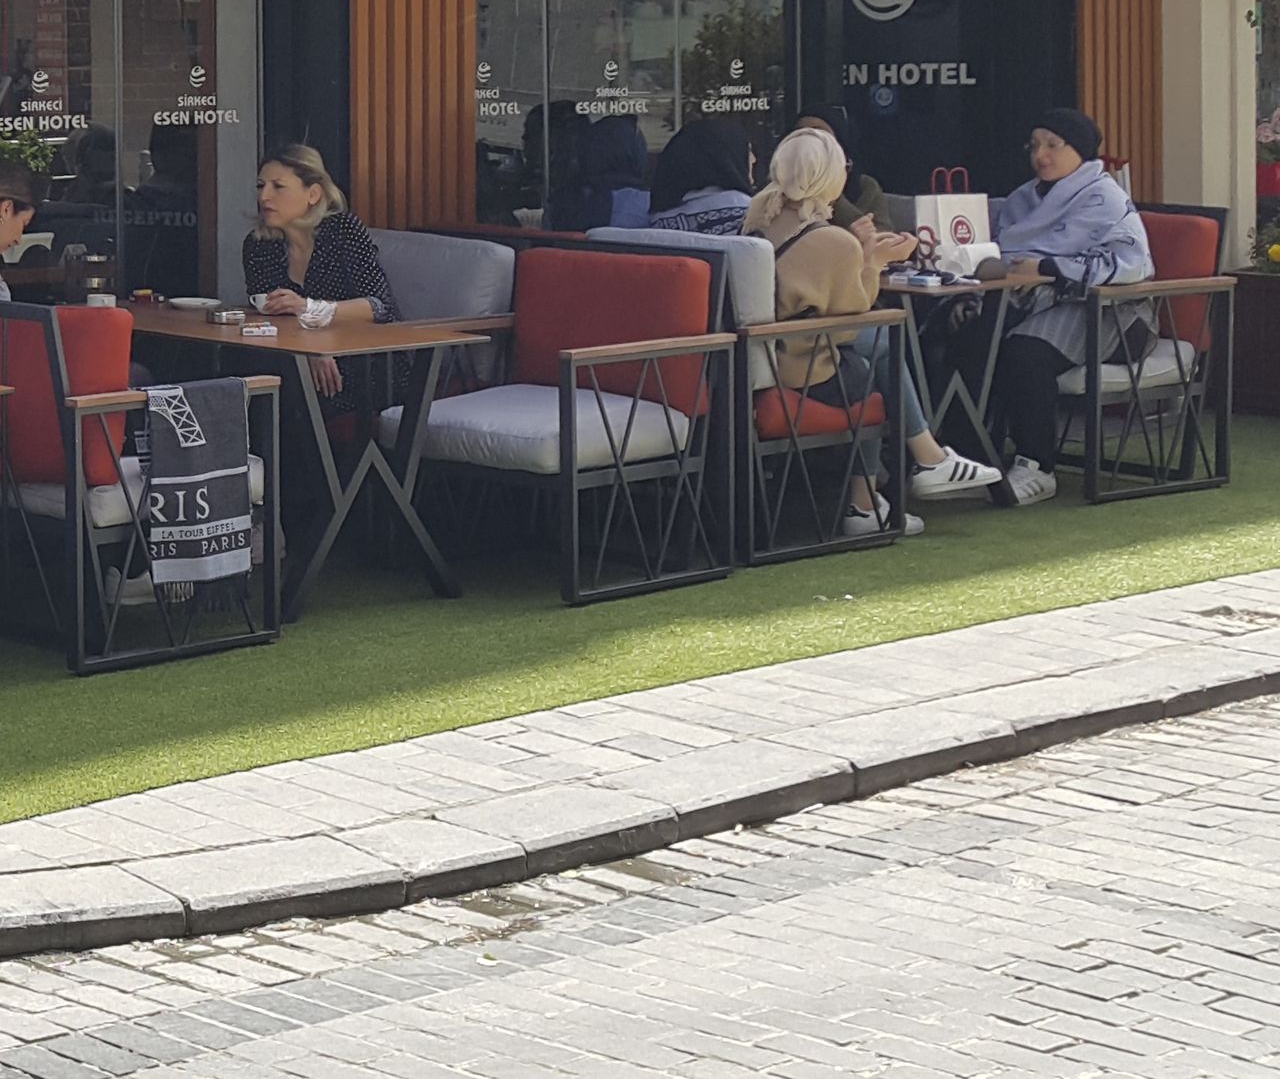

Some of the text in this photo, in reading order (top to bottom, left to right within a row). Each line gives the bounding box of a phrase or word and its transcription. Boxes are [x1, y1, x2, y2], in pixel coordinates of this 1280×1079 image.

[878, 62, 977, 85] HOTEL
[480, 101, 521, 116] HOTEL
[575, 100, 648, 114] ESEN HOTEL
[701, 97, 770, 112] ESEN HOTEL
[39, 114, 88, 131] HOTEL
[153, 109, 240, 125] ESEN HOTEL
[150, 486, 210, 523] RIS
[161, 522, 236, 539] LA TOUR EIFFEL
[150, 532, 246, 558] RIS PARIS
